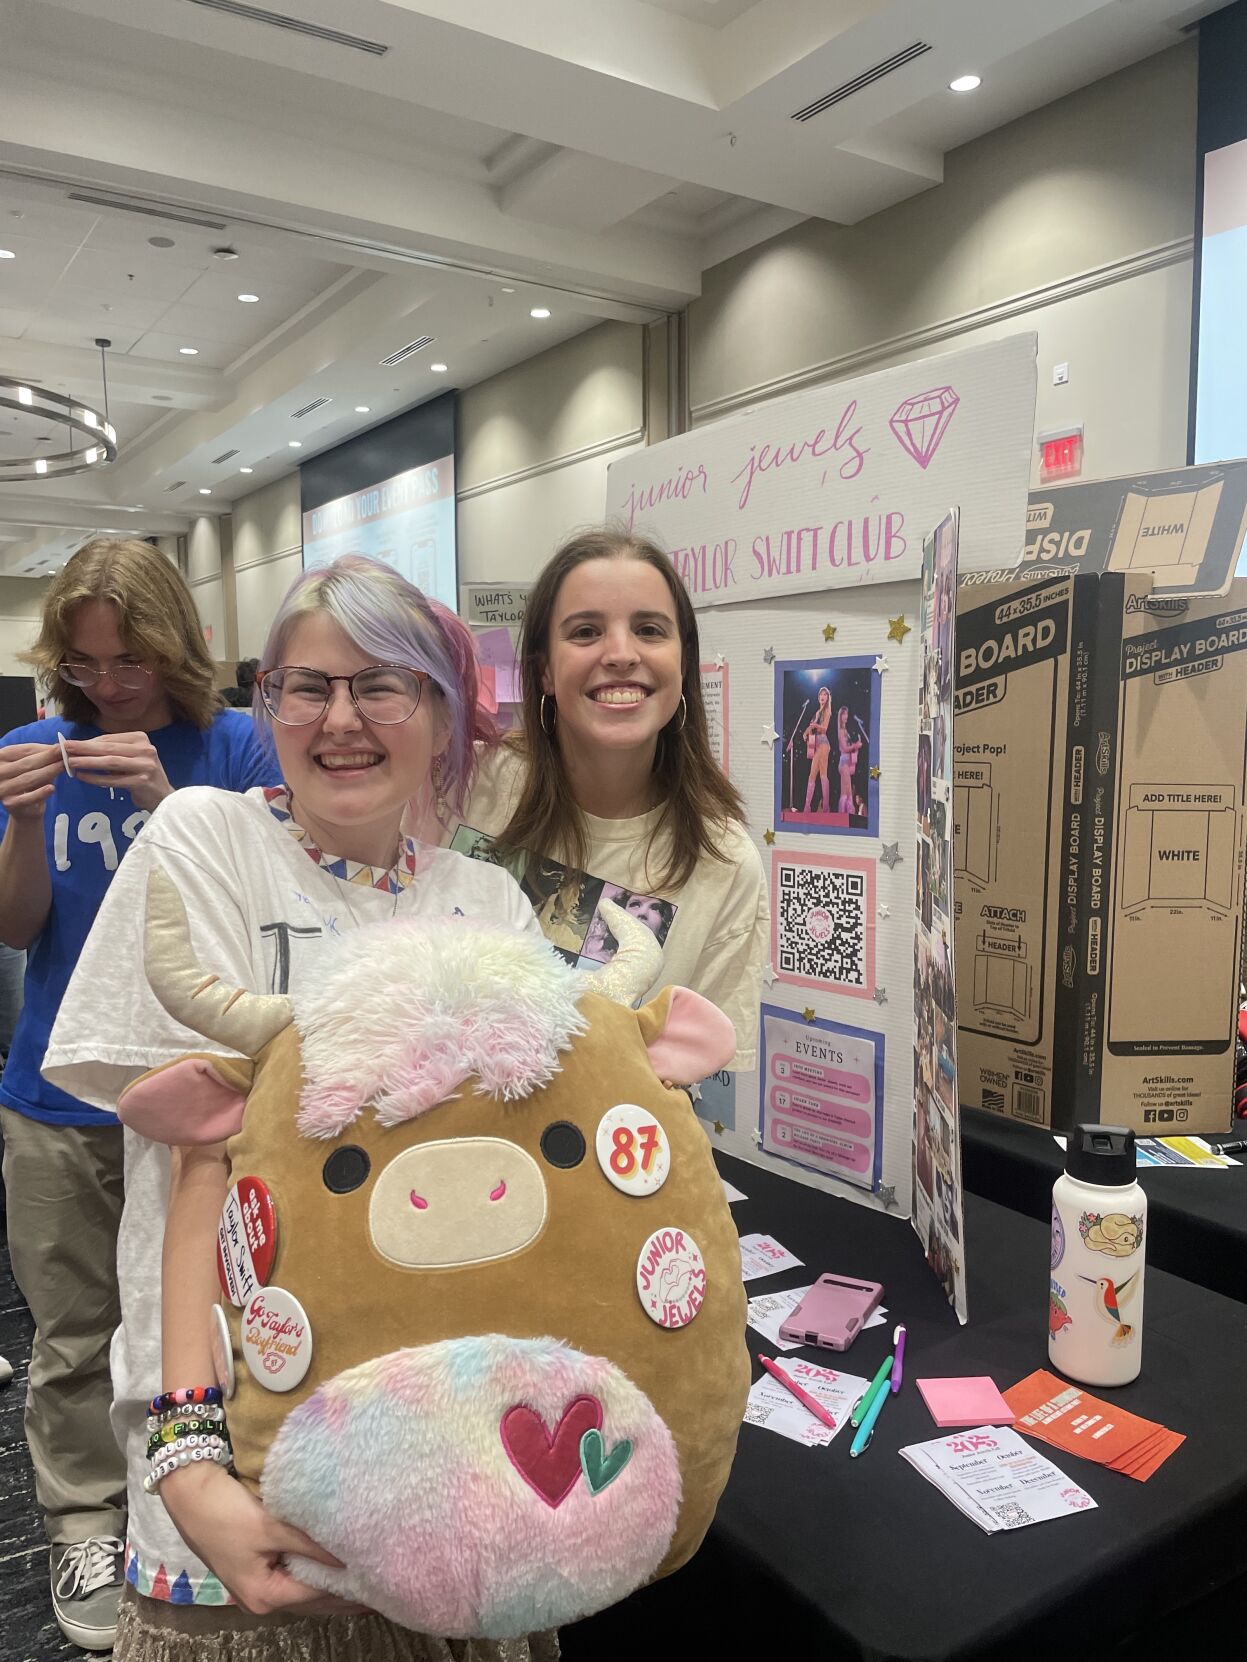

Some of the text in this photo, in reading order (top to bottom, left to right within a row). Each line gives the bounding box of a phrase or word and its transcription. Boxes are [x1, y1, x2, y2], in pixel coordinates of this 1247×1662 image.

[622, 400, 871, 532] junior jewels
[1044, 438, 1076, 468] EXIT
[1141, 523, 1184, 538] WHITE
[667, 511, 907, 593] TAYLOR SWIFT CLUB
[474, 591, 513, 607] WHAT'S
[1043, 587, 1070, 603] INCHES
[1126, 594, 1188, 615] ArtSkills
[959, 619, 1056, 677] BOARD
[1126, 640, 1158, 655] Project
[1126, 629, 1247, 674] DISPLAY BOARD
[1176, 659, 1218, 677] HEADER
[982, 744, 1006, 757] Pop!
[958, 770, 983, 781] HERE!
[1074, 749, 1083, 787] HEADER
[1143, 793, 1221, 804] ADD TITLE HERE!
[1069, 813, 1080, 854] BOARD
[1093, 817, 1105, 865] DISPLAY
[1158, 850, 1200, 862] WHITE
[1067, 857, 1079, 904] DISPLAY
[1091, 868, 1102, 908] BOARD
[980, 905, 1026, 922] ATTACH
[987, 941, 1016, 953] HEADER
[1089, 934, 1098, 972] HEADER
[795, 1041, 843, 1063] EVENTS
[980, 1075, 1007, 1088] OWNED
[1143, 1076, 1194, 1084] ArtSkills.com
[609, 1125, 662, 1178] 87
[243, 1202, 258, 1253] about
[249, 1188, 266, 1246] ask me
[224, 1193, 254, 1298] Taylor Swift
[639, 1231, 686, 1290] JUNIOR
[658, 1268, 706, 1328] JEWELS
[247, 1296, 304, 1339] Go Taylor's
[246, 1327, 302, 1356] Boyfriend
[949, 1457, 988, 1471] September
[997, 1449, 1023, 1461] October
[976, 1483, 1013, 1495] November
[1019, 1471, 1056, 1485] December
